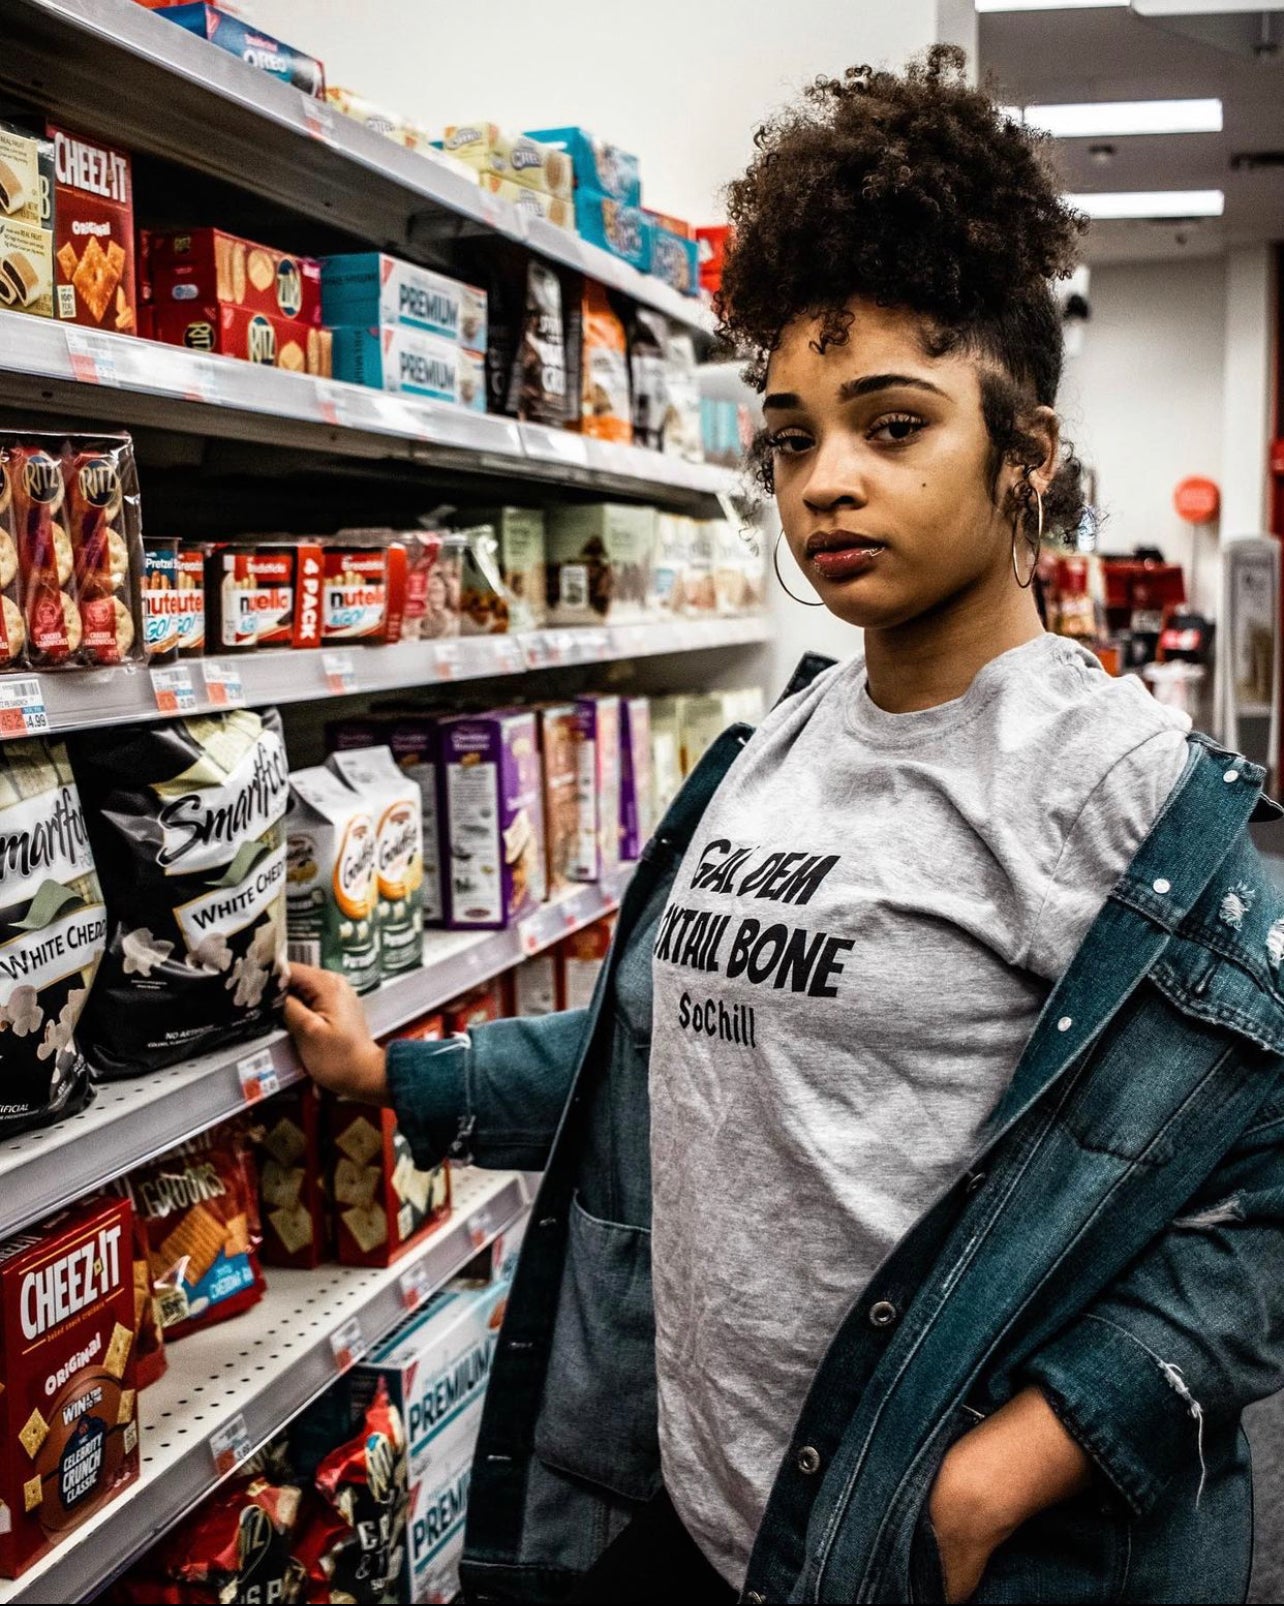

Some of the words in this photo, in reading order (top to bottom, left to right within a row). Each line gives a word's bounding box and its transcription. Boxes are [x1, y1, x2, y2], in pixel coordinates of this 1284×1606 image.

[400, 283, 460, 328] PREMIUM
[400, 350, 456, 390] PREMIUM
[25, 462, 60, 496] RITZ
[80, 465, 116, 501] RITZ
[303, 559, 319, 575] 4
[300, 578, 319, 640] PACK
[690, 839, 760, 894] GAL
[736, 852, 842, 906] DEM
[193, 888, 256, 930] WHITE
[0, 933, 65, 980] WHITE
[726, 918, 856, 998] BONE
[679, 992, 756, 1048] SoChill
[62, 1396, 87, 1426] WIN
[409, 1339, 494, 1443] PREMIUM
[62, 1447, 102, 1493] CRUNCH
[63, 1431, 103, 1472] CELEBRITY
[66, 1470, 97, 1504] CLASSIC
[413, 1469, 470, 1560] PREMI
